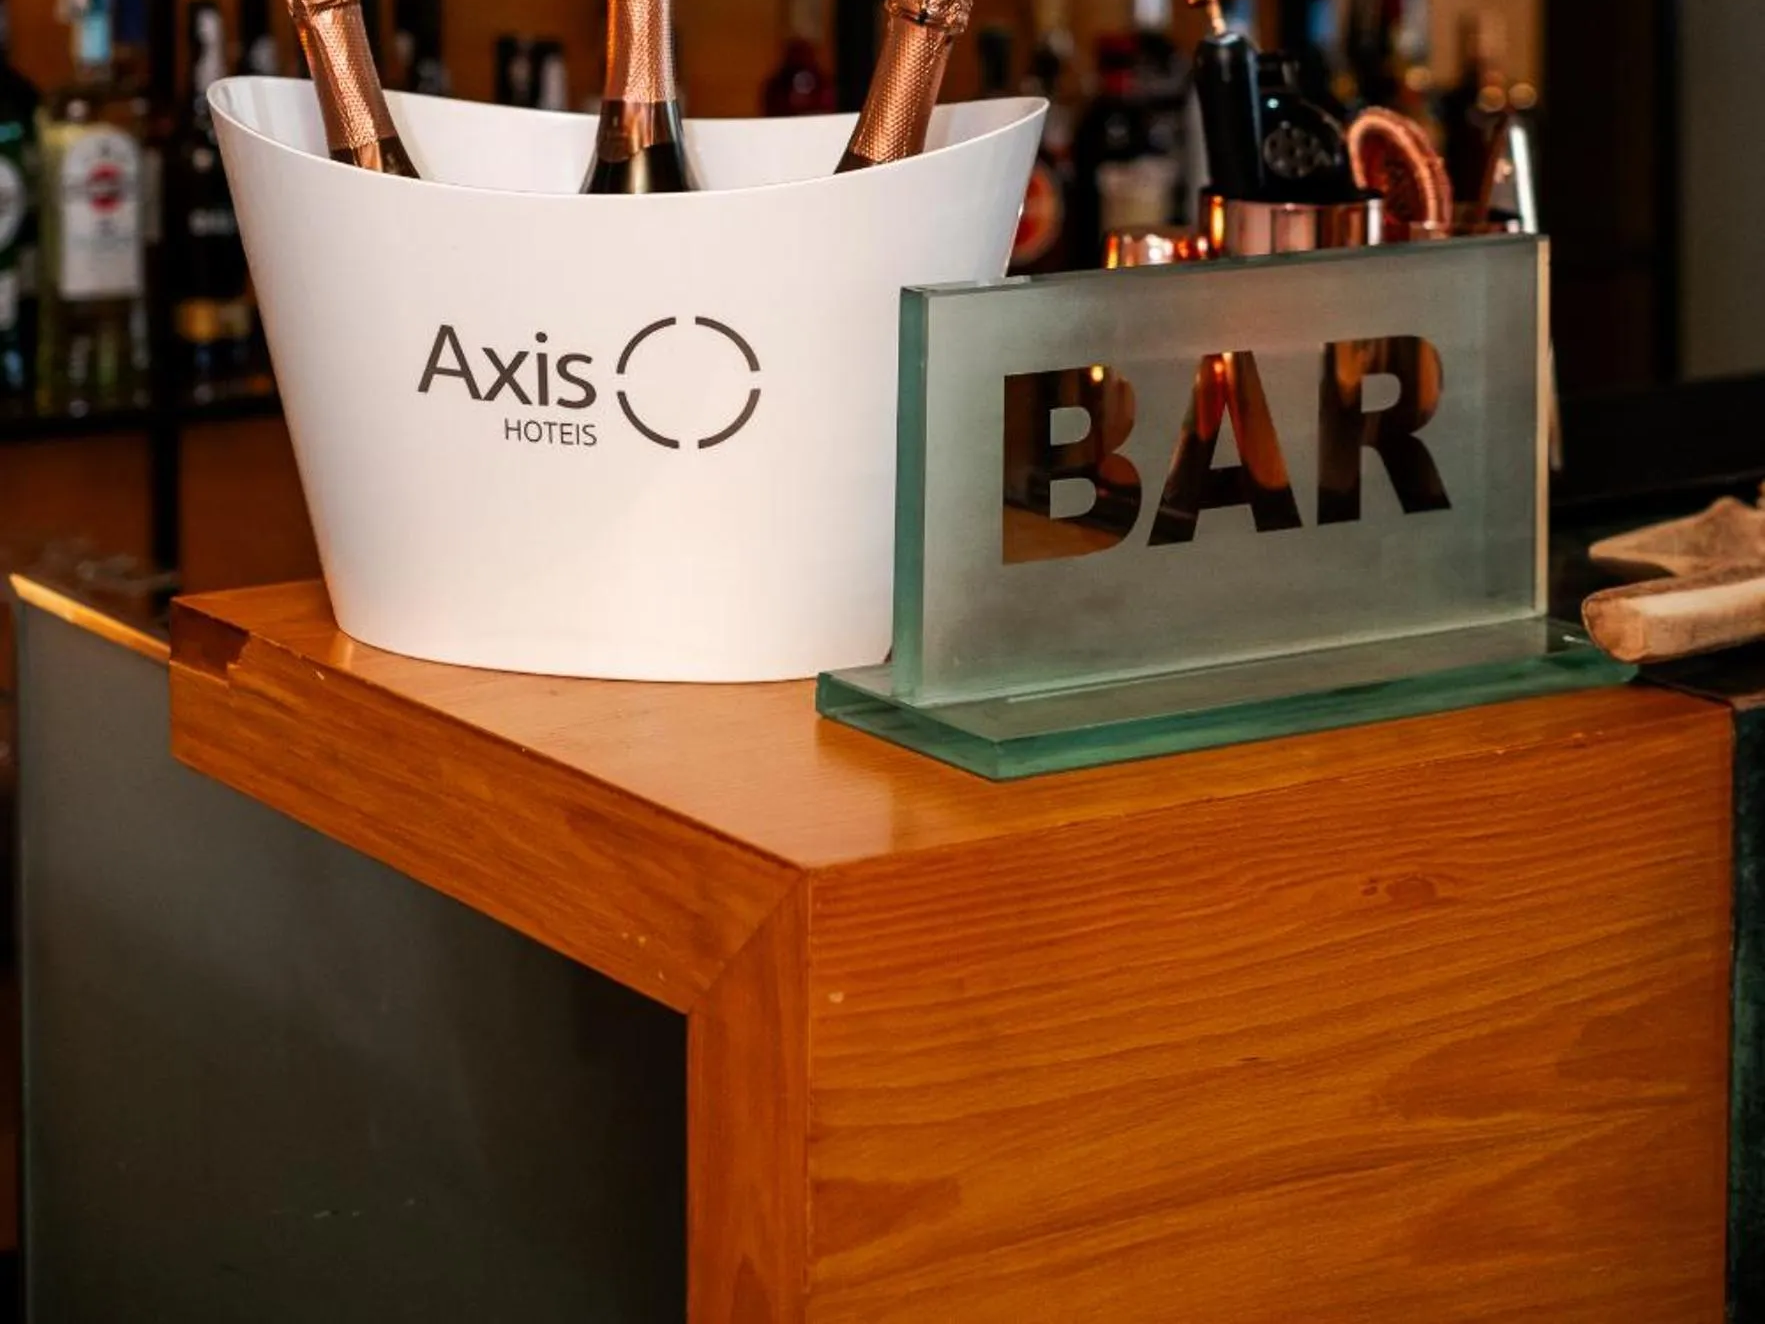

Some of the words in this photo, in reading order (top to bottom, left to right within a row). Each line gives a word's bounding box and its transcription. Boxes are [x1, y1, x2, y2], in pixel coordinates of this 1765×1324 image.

[417, 324, 598, 410] Axis
[503, 417, 598, 447] HOTEIS
[1002, 333, 1452, 566] BAR
